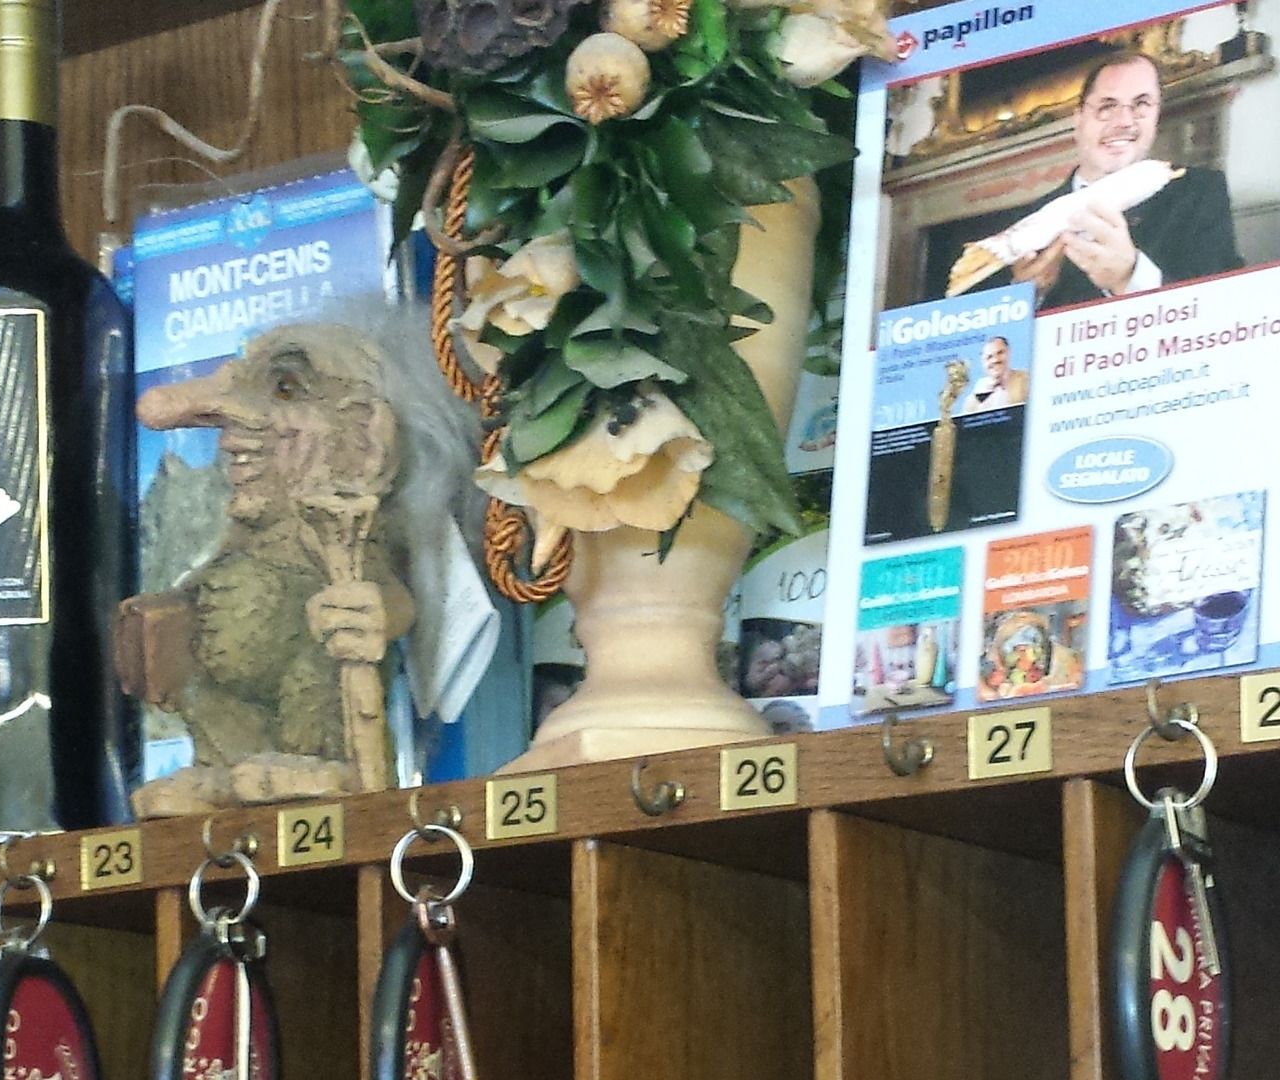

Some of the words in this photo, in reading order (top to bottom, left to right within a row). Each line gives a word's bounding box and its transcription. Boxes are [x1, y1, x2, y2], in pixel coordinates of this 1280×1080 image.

[923, 5, 1033, 50] papillon
[169, 240, 333, 304] MONT-CENIS
[1055, 327, 1062, 346] I
[1070, 314, 1118, 343] libri
[1125, 297, 1200, 338] golosi
[1054, 355, 1075, 378] di
[1083, 343, 1149, 373] Paolo
[1075, 450, 1136, 470] LOCALE
[986, 720, 1036, 765] 27
[735, 756, 786, 796] 26
[500, 787, 547, 826] 25
[291, 815, 334, 854] 24
[93, 841, 134, 878] 23
[1150, 920, 1196, 1052] 28
